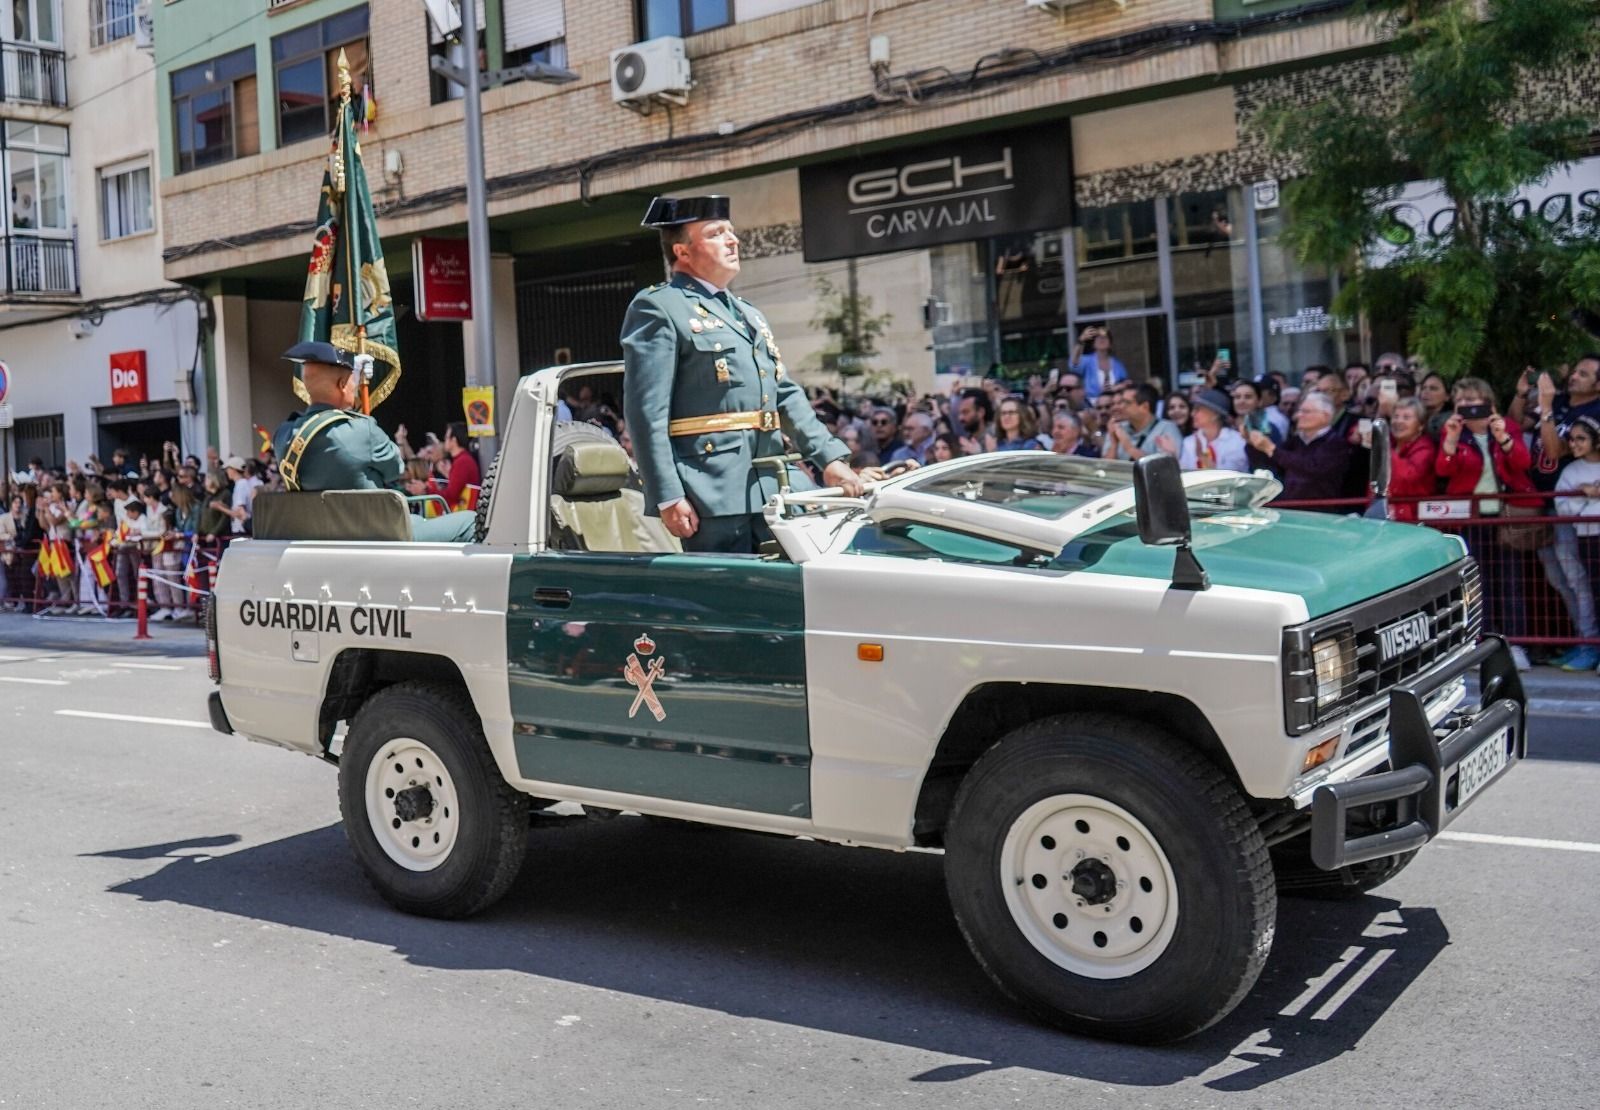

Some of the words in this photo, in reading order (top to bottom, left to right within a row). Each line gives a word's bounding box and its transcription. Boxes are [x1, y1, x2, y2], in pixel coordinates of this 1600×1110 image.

[848, 147, 1013, 203] GCH
[866, 198, 997, 238] CARVAJAL
[240, 599, 342, 633] GUARDIA
[350, 606, 412, 639] CIVIL
[1380, 615, 1430, 661] NISSAN
